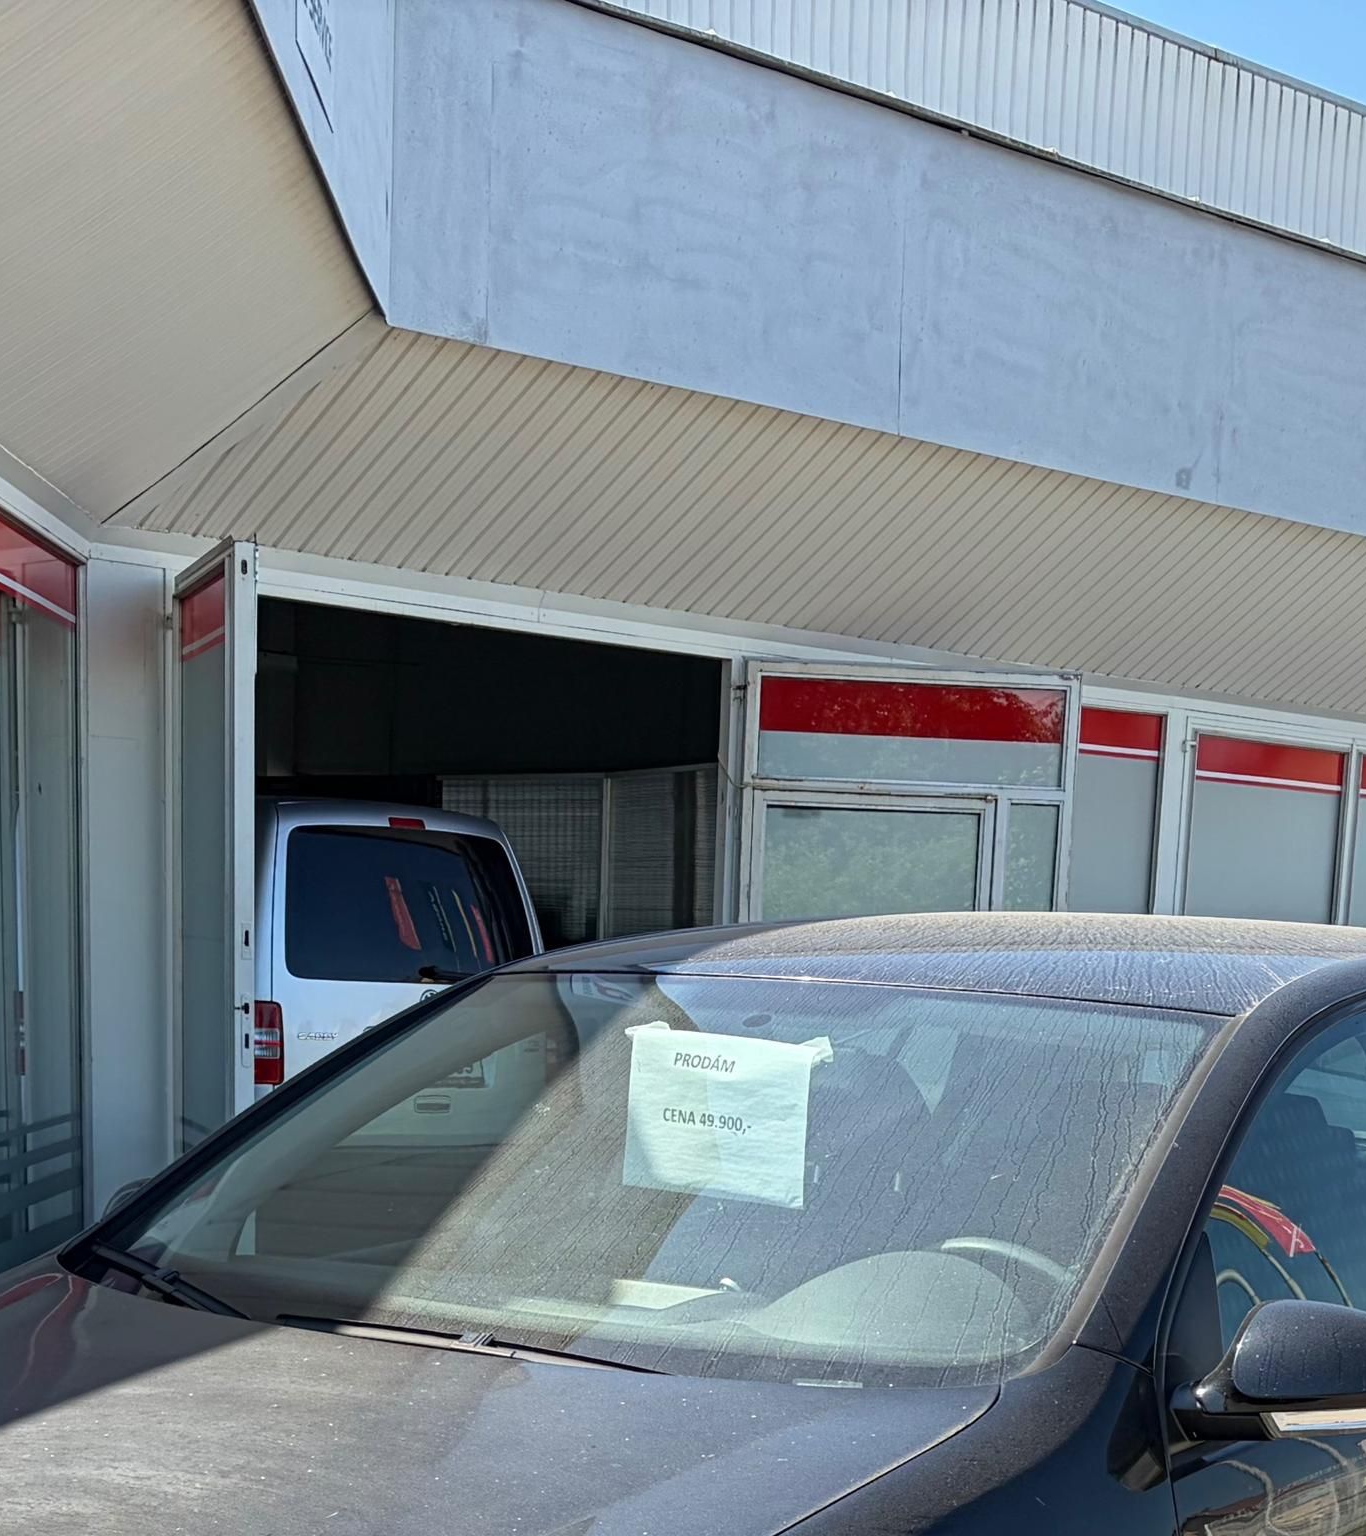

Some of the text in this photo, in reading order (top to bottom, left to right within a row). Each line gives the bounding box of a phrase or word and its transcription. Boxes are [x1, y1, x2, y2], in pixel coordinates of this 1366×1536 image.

[673, 1052, 735, 1073] PRODÁM
[663, 1107, 752, 1135] CENA 49.900,-
